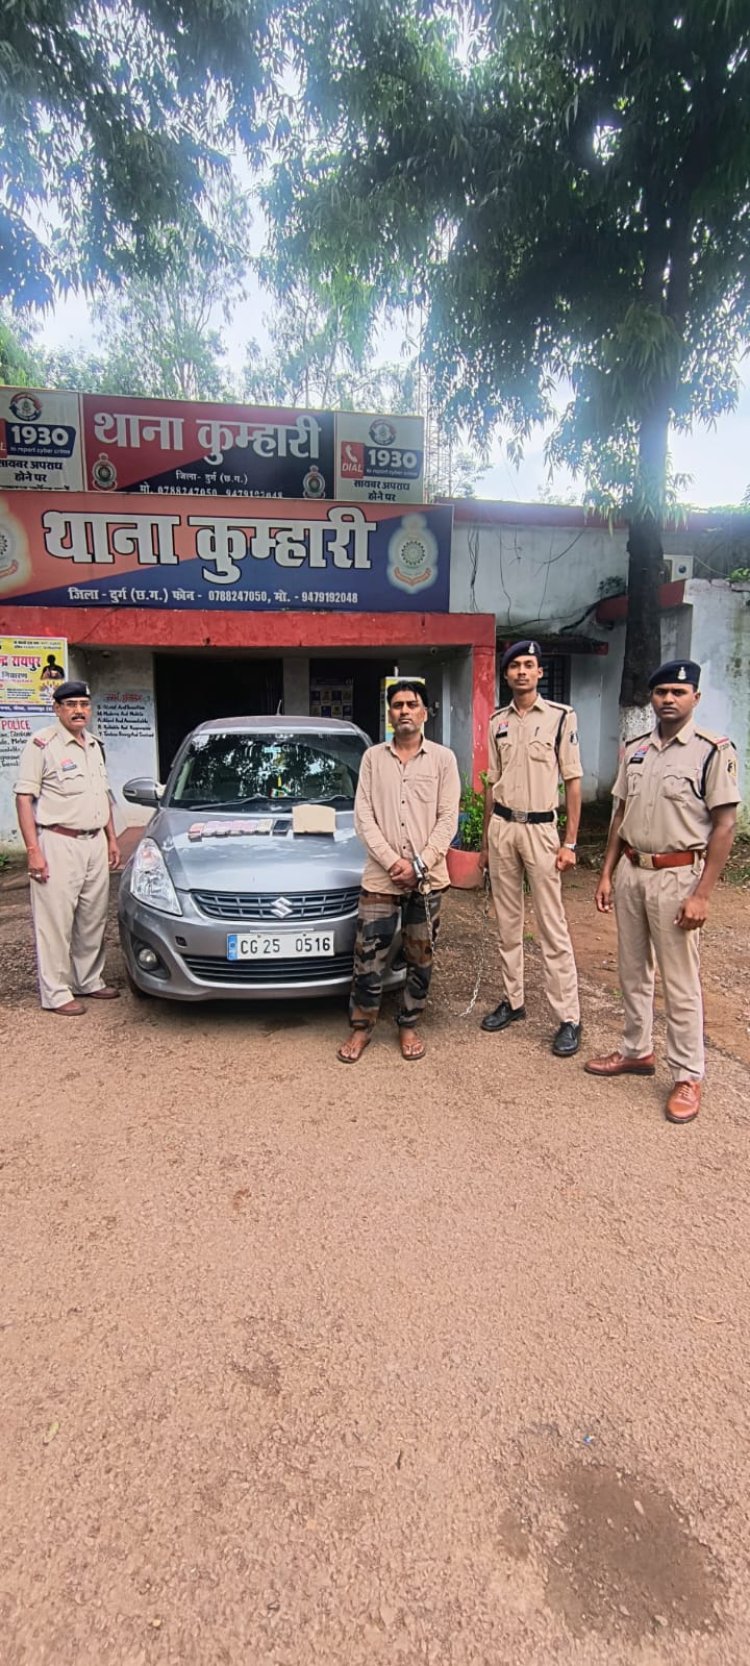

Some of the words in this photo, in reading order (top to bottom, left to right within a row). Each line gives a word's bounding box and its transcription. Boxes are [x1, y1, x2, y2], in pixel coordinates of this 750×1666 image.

[11, 425, 69, 446] 1930
[94, 412, 184, 450] थाना
[196, 415, 322, 465] कुम्हारी
[30, 461, 63, 470] अपराध
[342, 463, 363, 473] DIAL
[368, 449, 417, 469] 1930
[14, 471, 32, 482] होने
[33, 474, 47, 482] पर
[368, 491, 383, 500] होने
[385, 493, 397, 501] पर
[42, 510, 181, 565] थाना
[188, 505, 377, 584] कुम्हारी
[68, 587, 99, 600] जिला
[109, 588, 127, 603] दुर्ग
[130, 589, 168, 602] (छ.ग.)
[172, 589, 195, 601] फोन
[273, 589, 291, 602] मो.
[302, 592, 358, 603] 9479192048
[12, 656, 41, 671] रायपुर
[2, 719, 30, 730] POLICE
[240, 940, 258, 954] CG
[263, 939, 280, 954] 25
[295, 938, 330, 952] 0516
